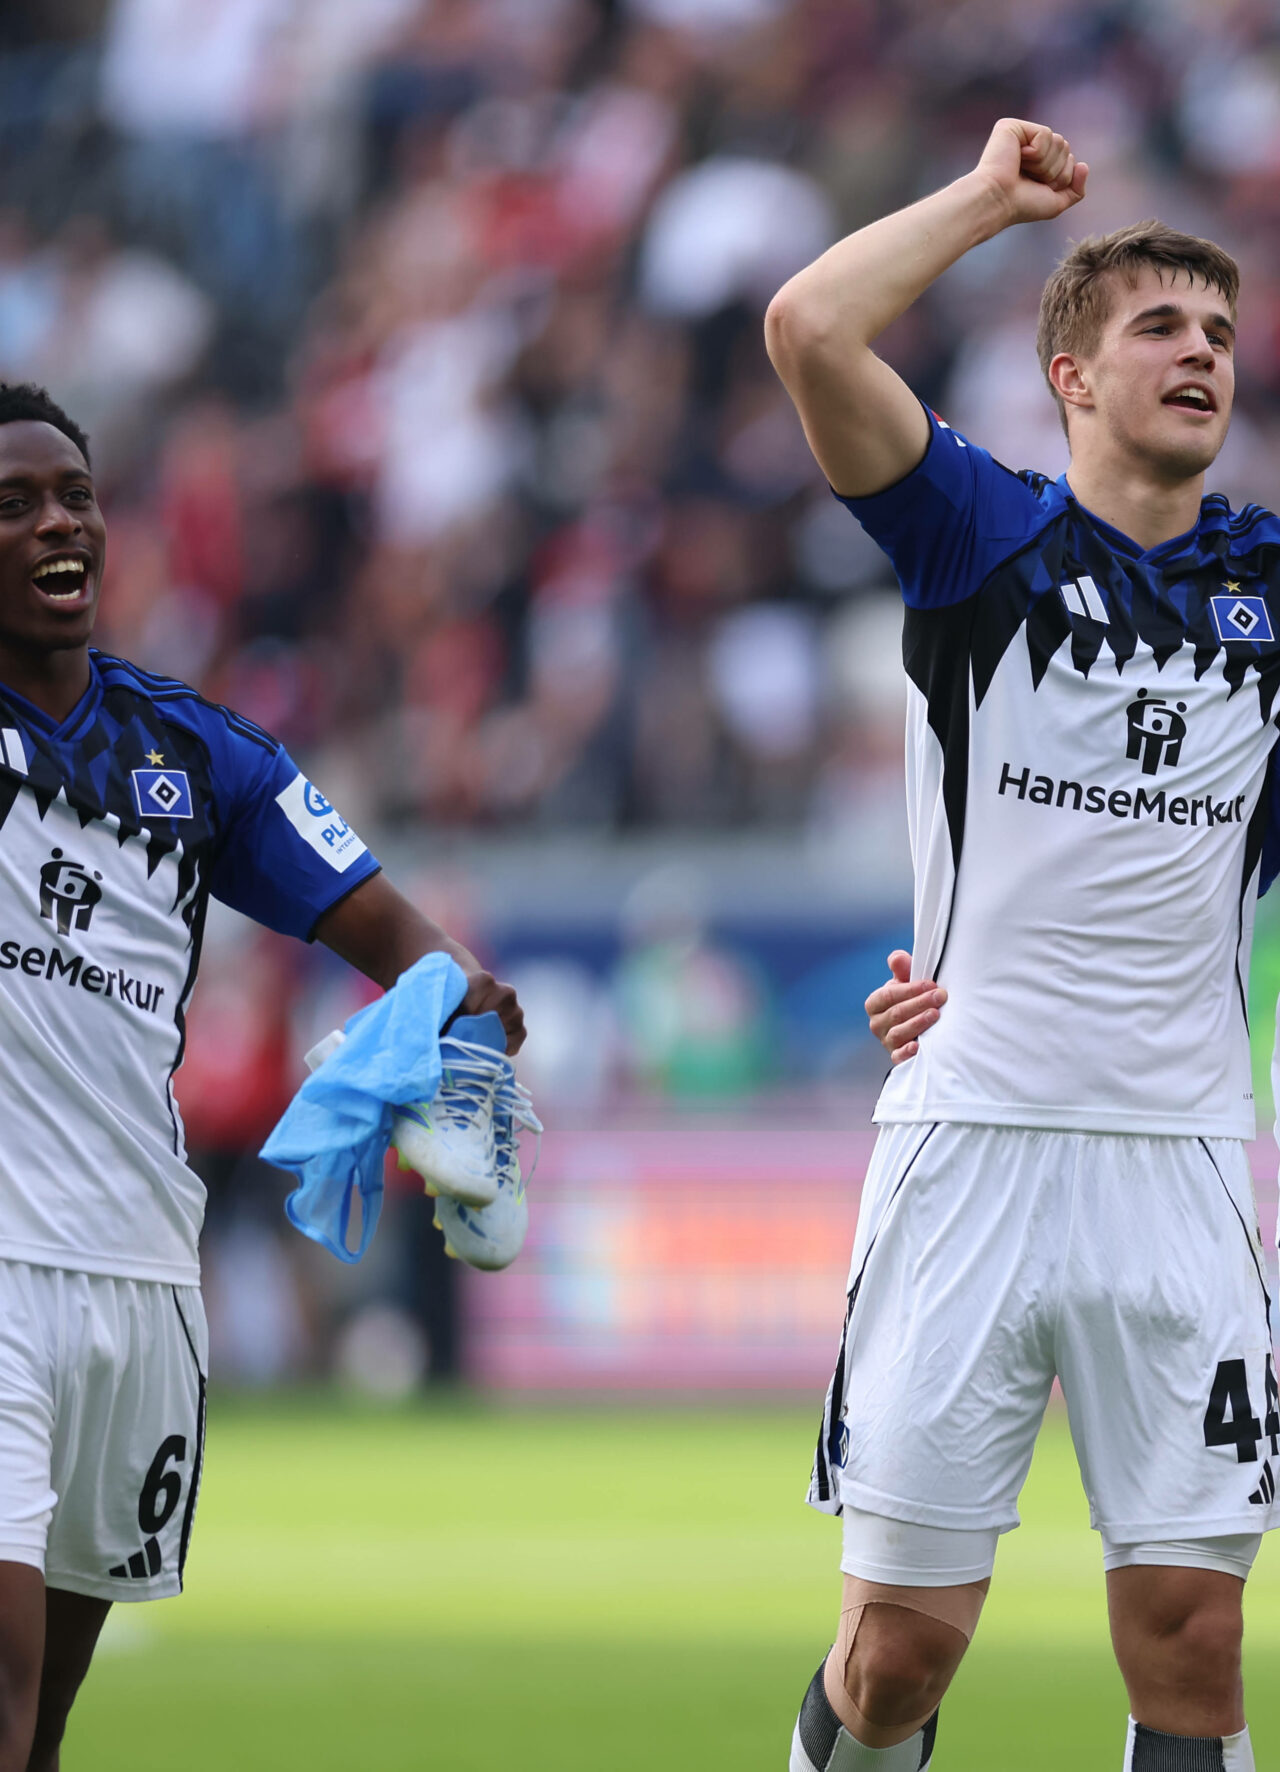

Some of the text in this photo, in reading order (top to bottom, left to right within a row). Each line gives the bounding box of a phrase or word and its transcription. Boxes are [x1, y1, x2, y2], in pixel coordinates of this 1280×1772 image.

[998, 762, 1246, 827] HanseMerkur
[0, 941, 165, 1013] seMerkur
[138, 1434, 187, 1535] 6
